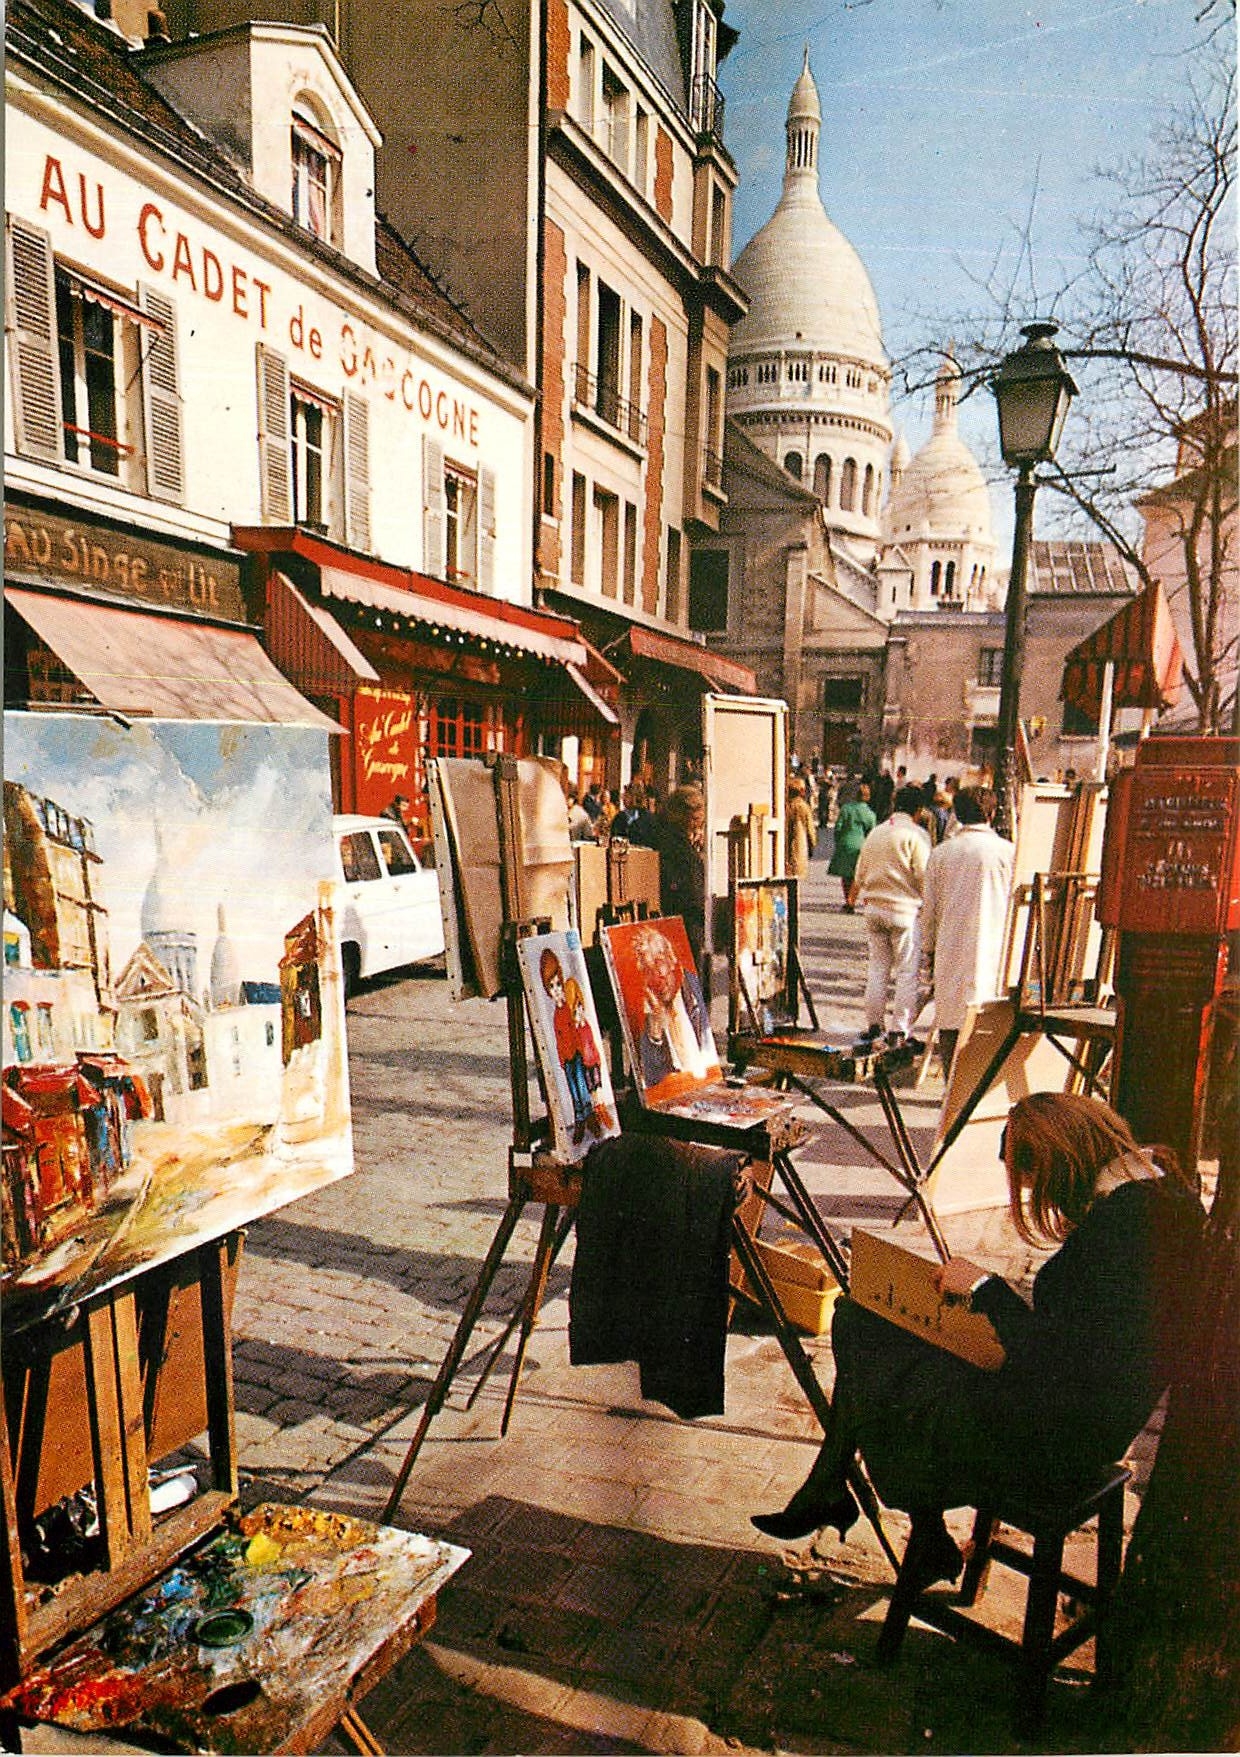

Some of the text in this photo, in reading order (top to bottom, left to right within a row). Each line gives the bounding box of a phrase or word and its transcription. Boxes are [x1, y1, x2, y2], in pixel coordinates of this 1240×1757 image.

[40, 155, 106, 240] AU
[138, 203, 272, 330] CADET
[290, 304, 323, 359] de
